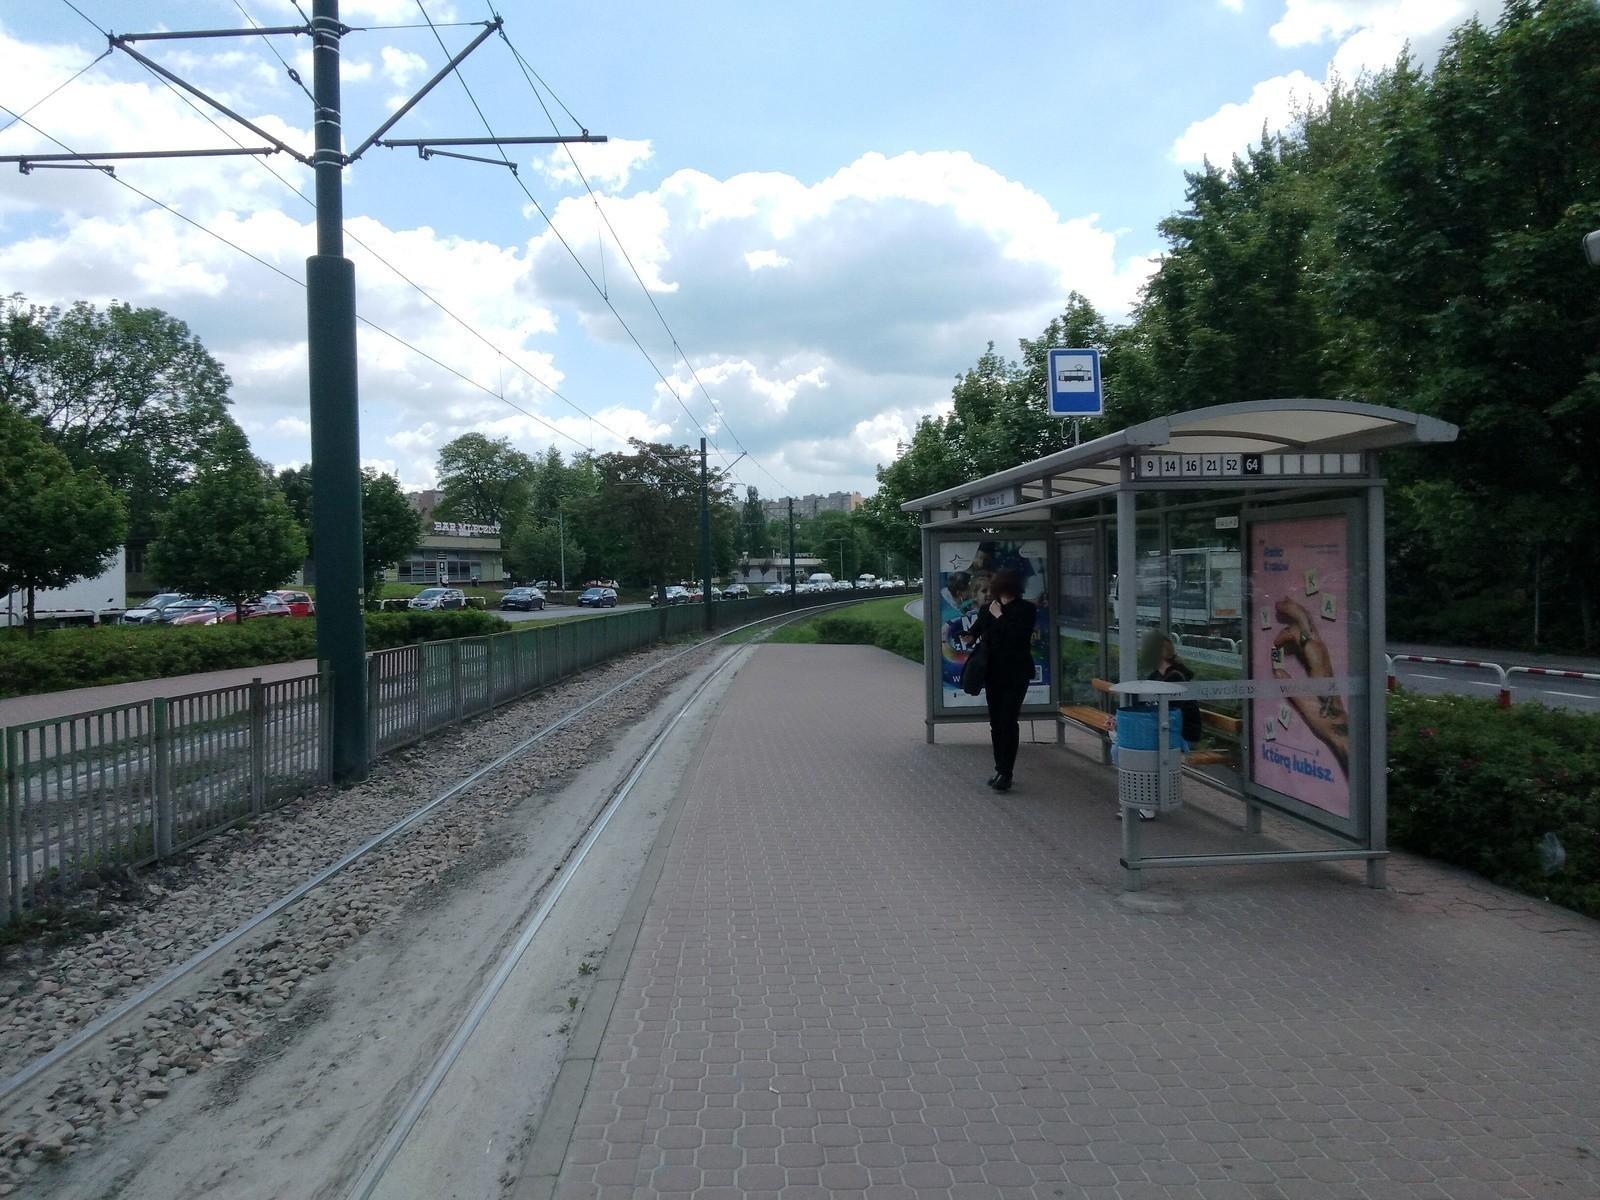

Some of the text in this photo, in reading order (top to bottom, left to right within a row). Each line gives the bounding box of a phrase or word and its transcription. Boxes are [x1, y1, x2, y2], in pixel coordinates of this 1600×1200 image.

[1147, 459, 1259, 471] 9 14 16 21 52 64
[434, 521, 501, 535] BAR MLECZNY
